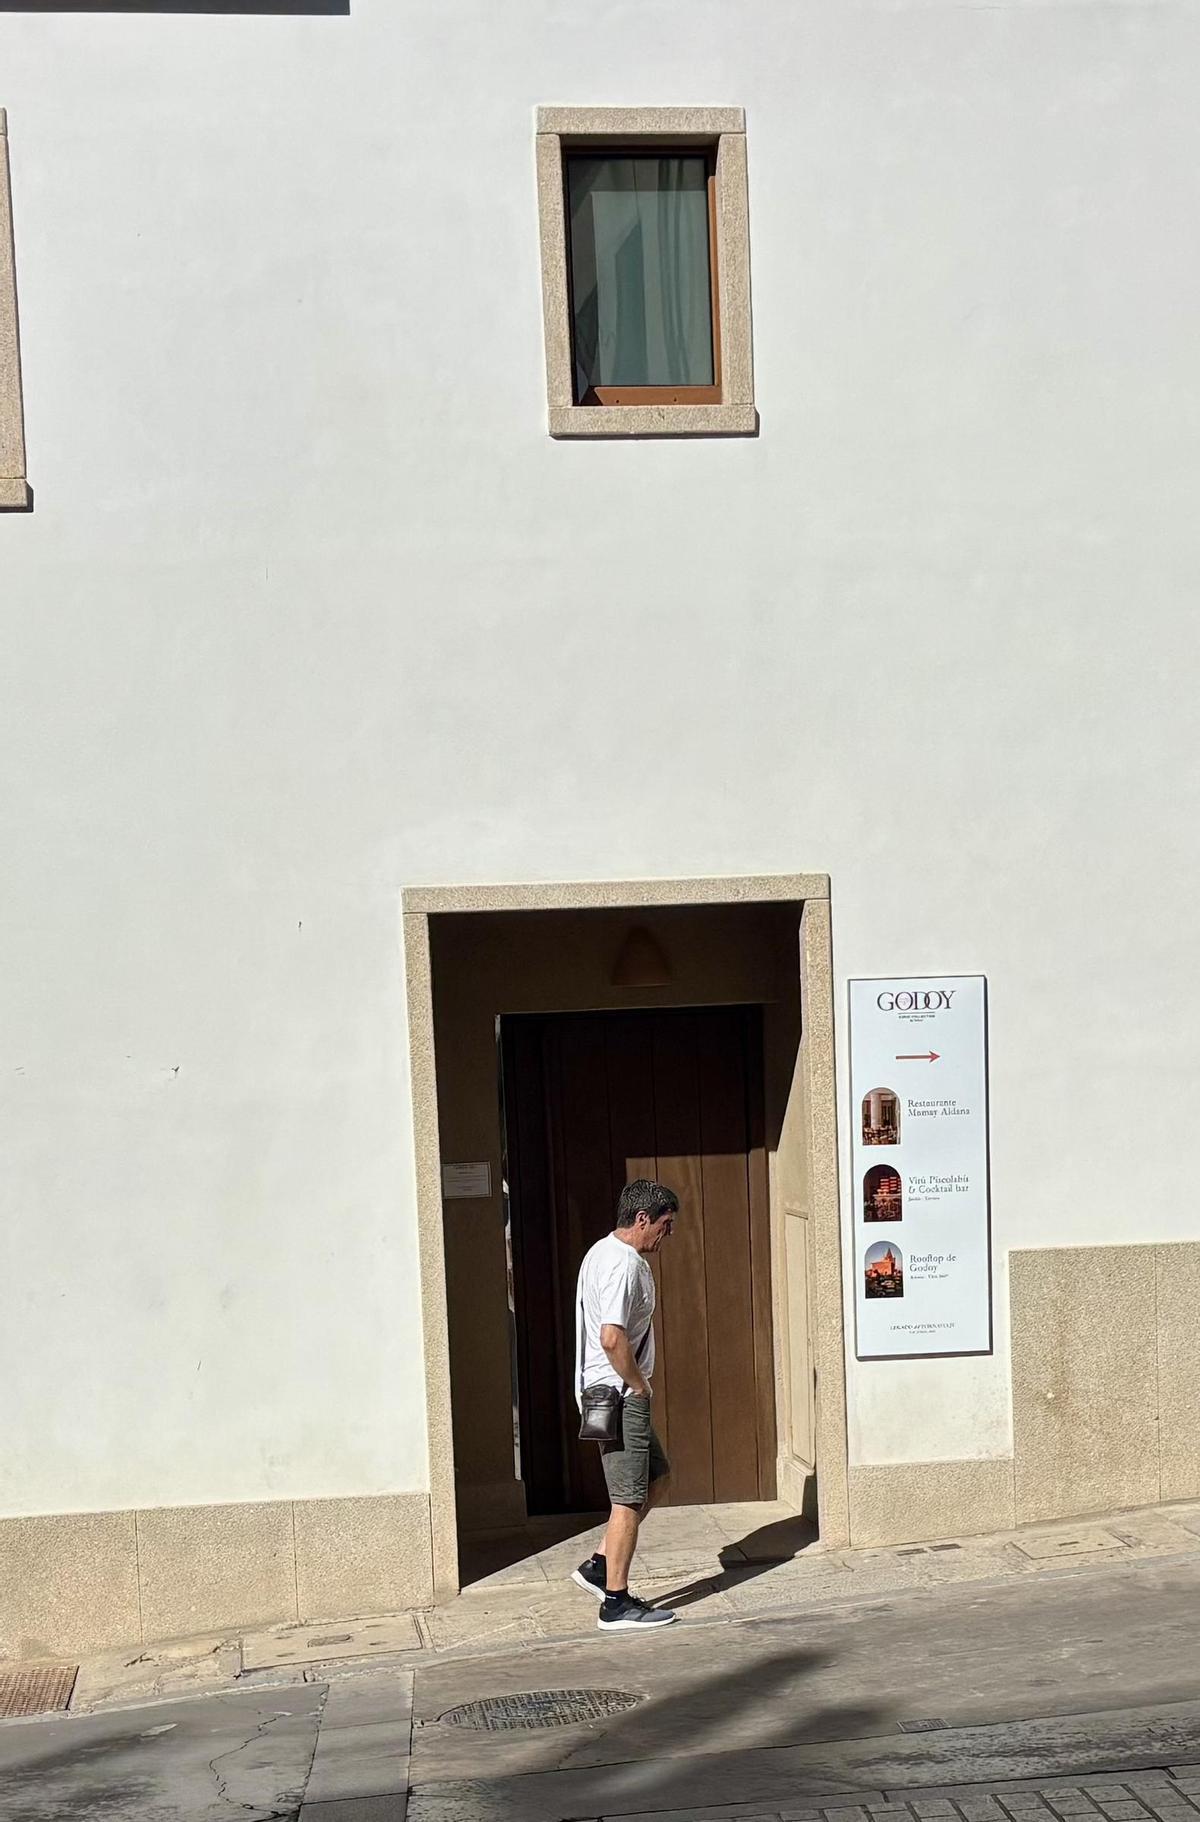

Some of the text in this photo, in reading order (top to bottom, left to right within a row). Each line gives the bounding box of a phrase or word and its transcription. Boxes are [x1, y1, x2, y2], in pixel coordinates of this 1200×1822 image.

[877, 990, 956, 1011] GODOY
[908, 1099, 957, 1108] Restaurante
[918, 1184, 953, 1194] Cocktail
[955, 1183, 969, 1193] bar
[910, 1253, 957, 1265] Rooftop de
[909, 1263, 937, 1274] Godoy
